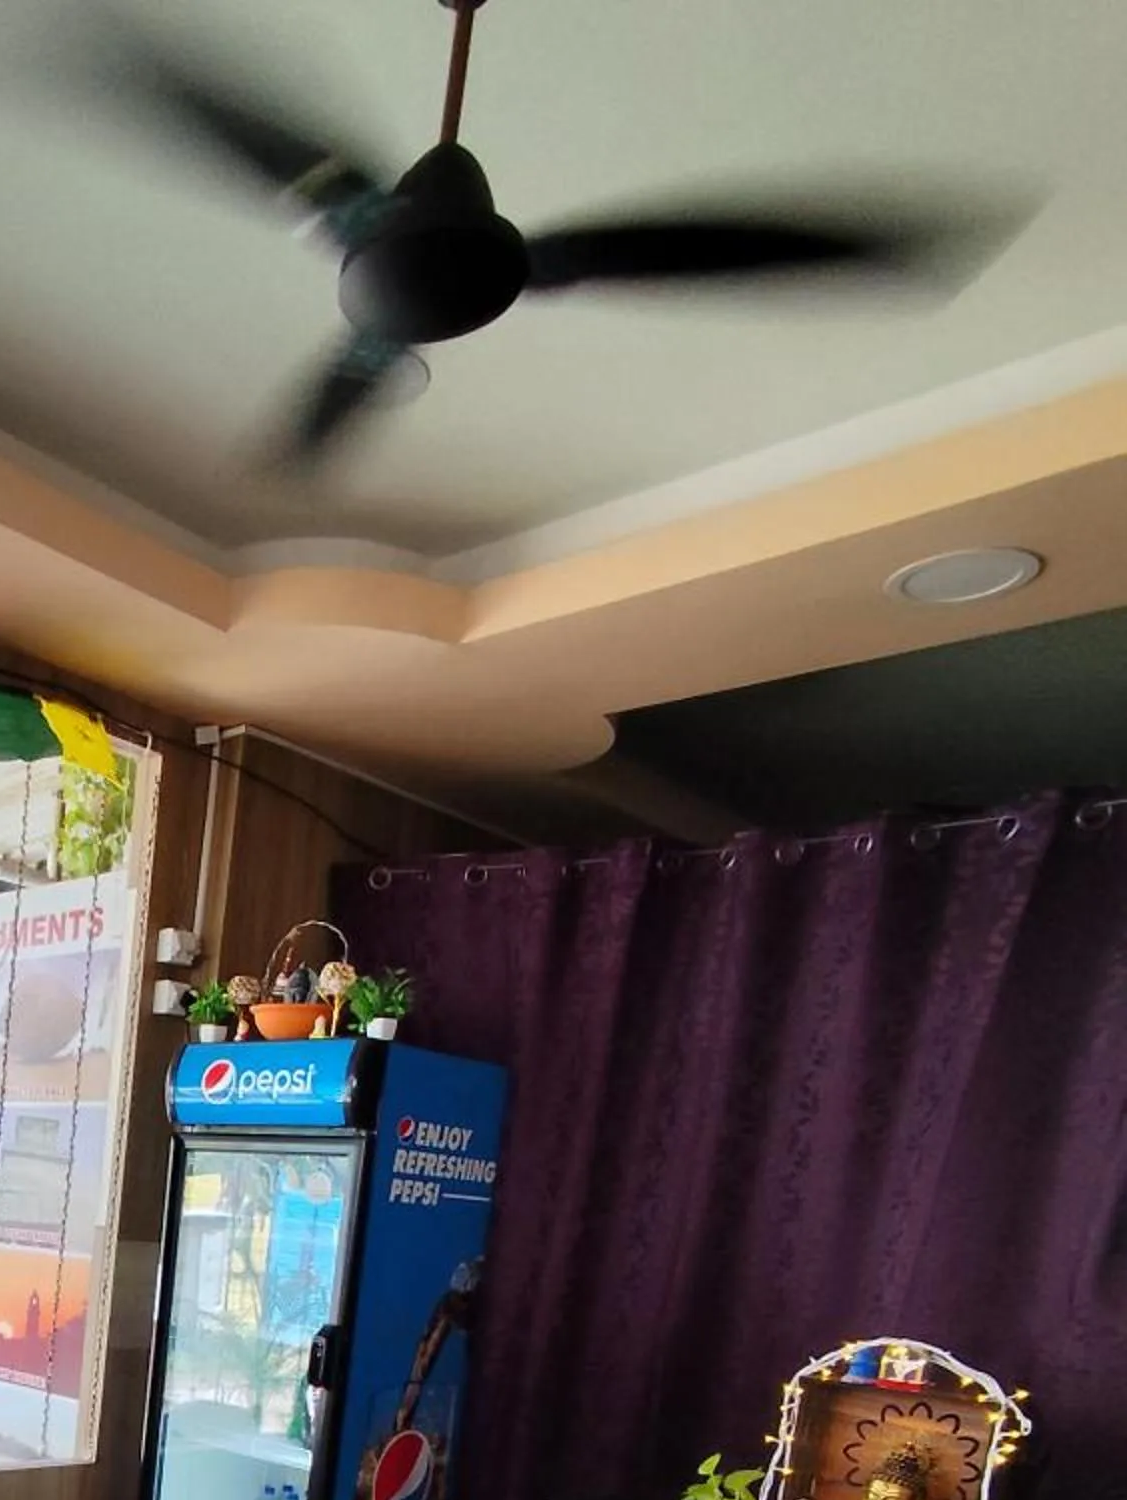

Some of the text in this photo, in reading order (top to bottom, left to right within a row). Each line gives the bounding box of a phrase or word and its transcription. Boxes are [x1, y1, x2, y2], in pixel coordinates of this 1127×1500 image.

[239, 1063, 315, 1100] pepsi
[415, 1121, 473, 1151] ENJOY
[393, 1149, 497, 1183] REFRESHING
[388, 1178, 441, 1206] PEPSI
